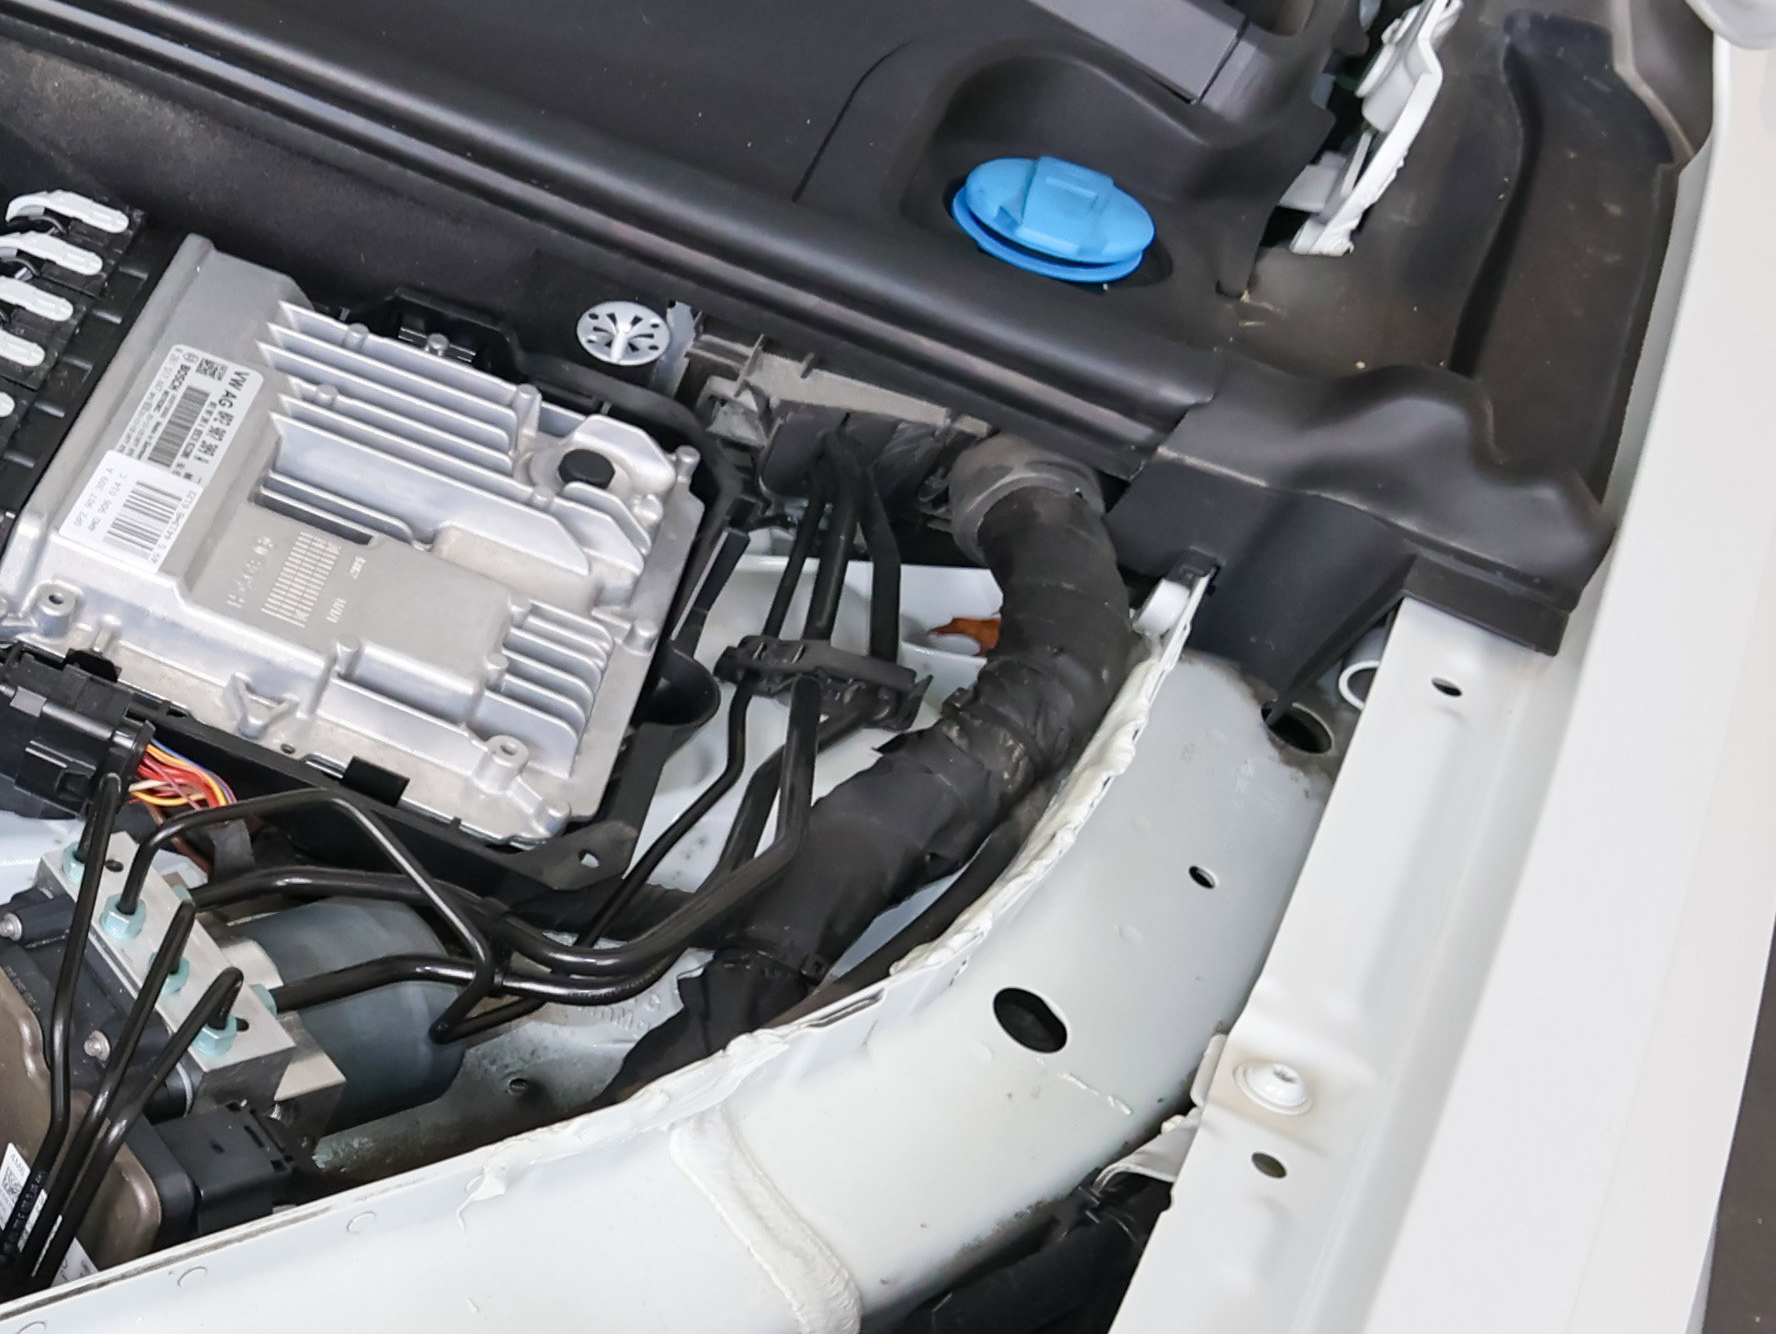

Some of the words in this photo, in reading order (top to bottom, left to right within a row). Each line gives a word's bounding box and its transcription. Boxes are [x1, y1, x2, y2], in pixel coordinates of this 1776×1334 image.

[170, 364, 189, 390] BOSCH
[228, 370, 247, 389] VW
[219, 390, 236, 407] AG
